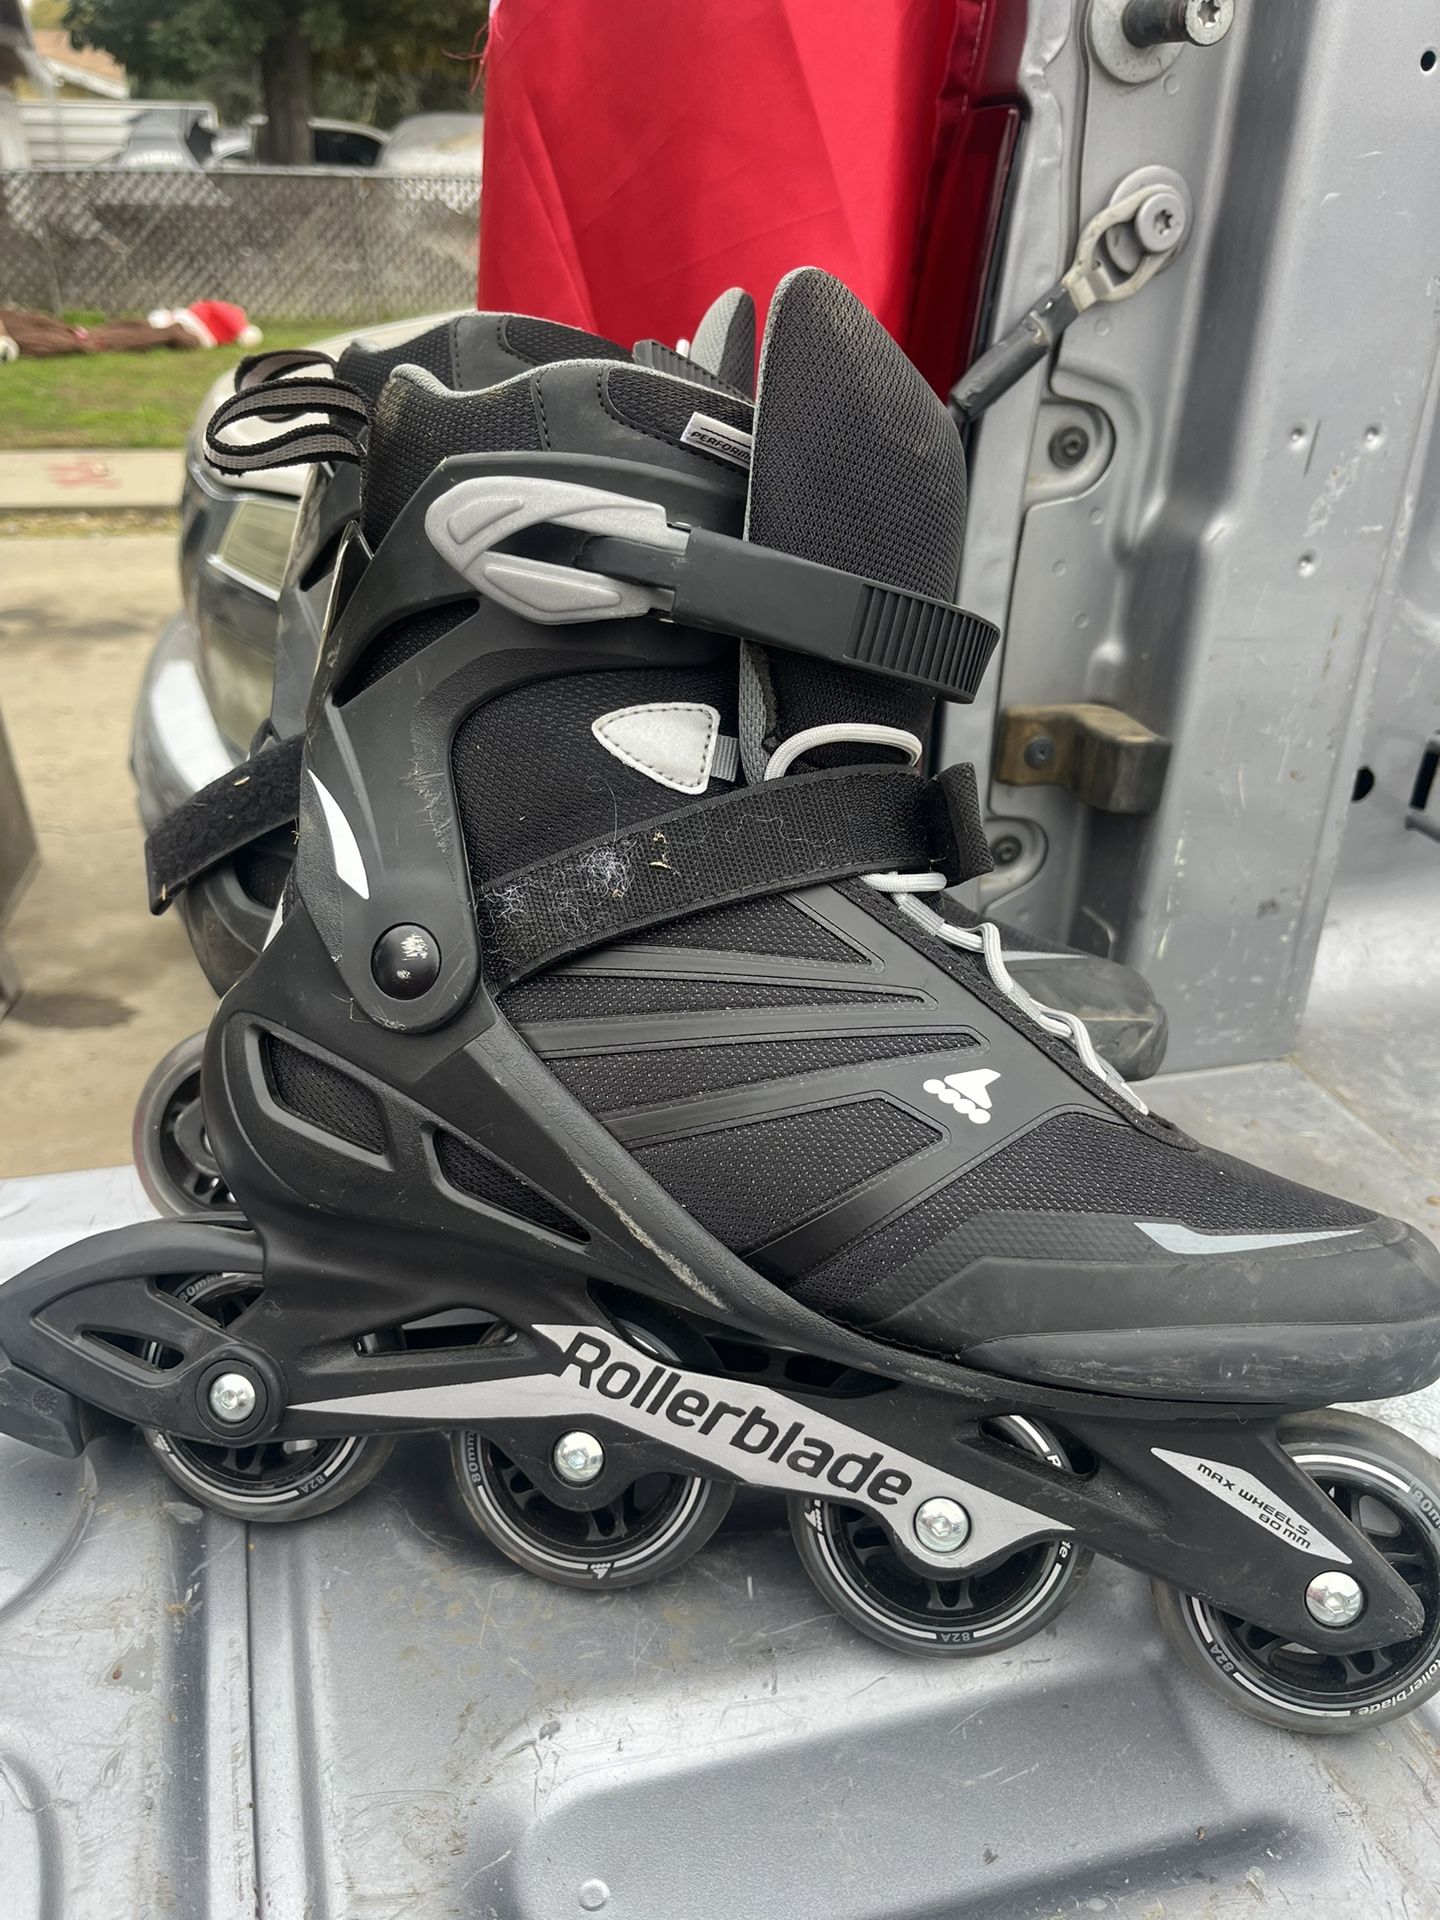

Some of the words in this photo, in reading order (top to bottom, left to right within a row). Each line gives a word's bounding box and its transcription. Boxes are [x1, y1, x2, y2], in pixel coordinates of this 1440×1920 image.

[691, 431, 752, 460] PERFORM
[556, 1331, 913, 1505] Rollerblade
[299, 1474, 325, 1493] 82A
[1197, 1463, 1235, 1491] MAX
[1238, 1488, 1310, 1536] WHEELS
[1412, 1488, 1440, 1529] 80m
[1258, 1512, 1281, 1531] 80
[1282, 1528, 1312, 1549] mm
[940, 1632, 971, 1642] 82A
[1210, 1643, 1234, 1672] 82A
